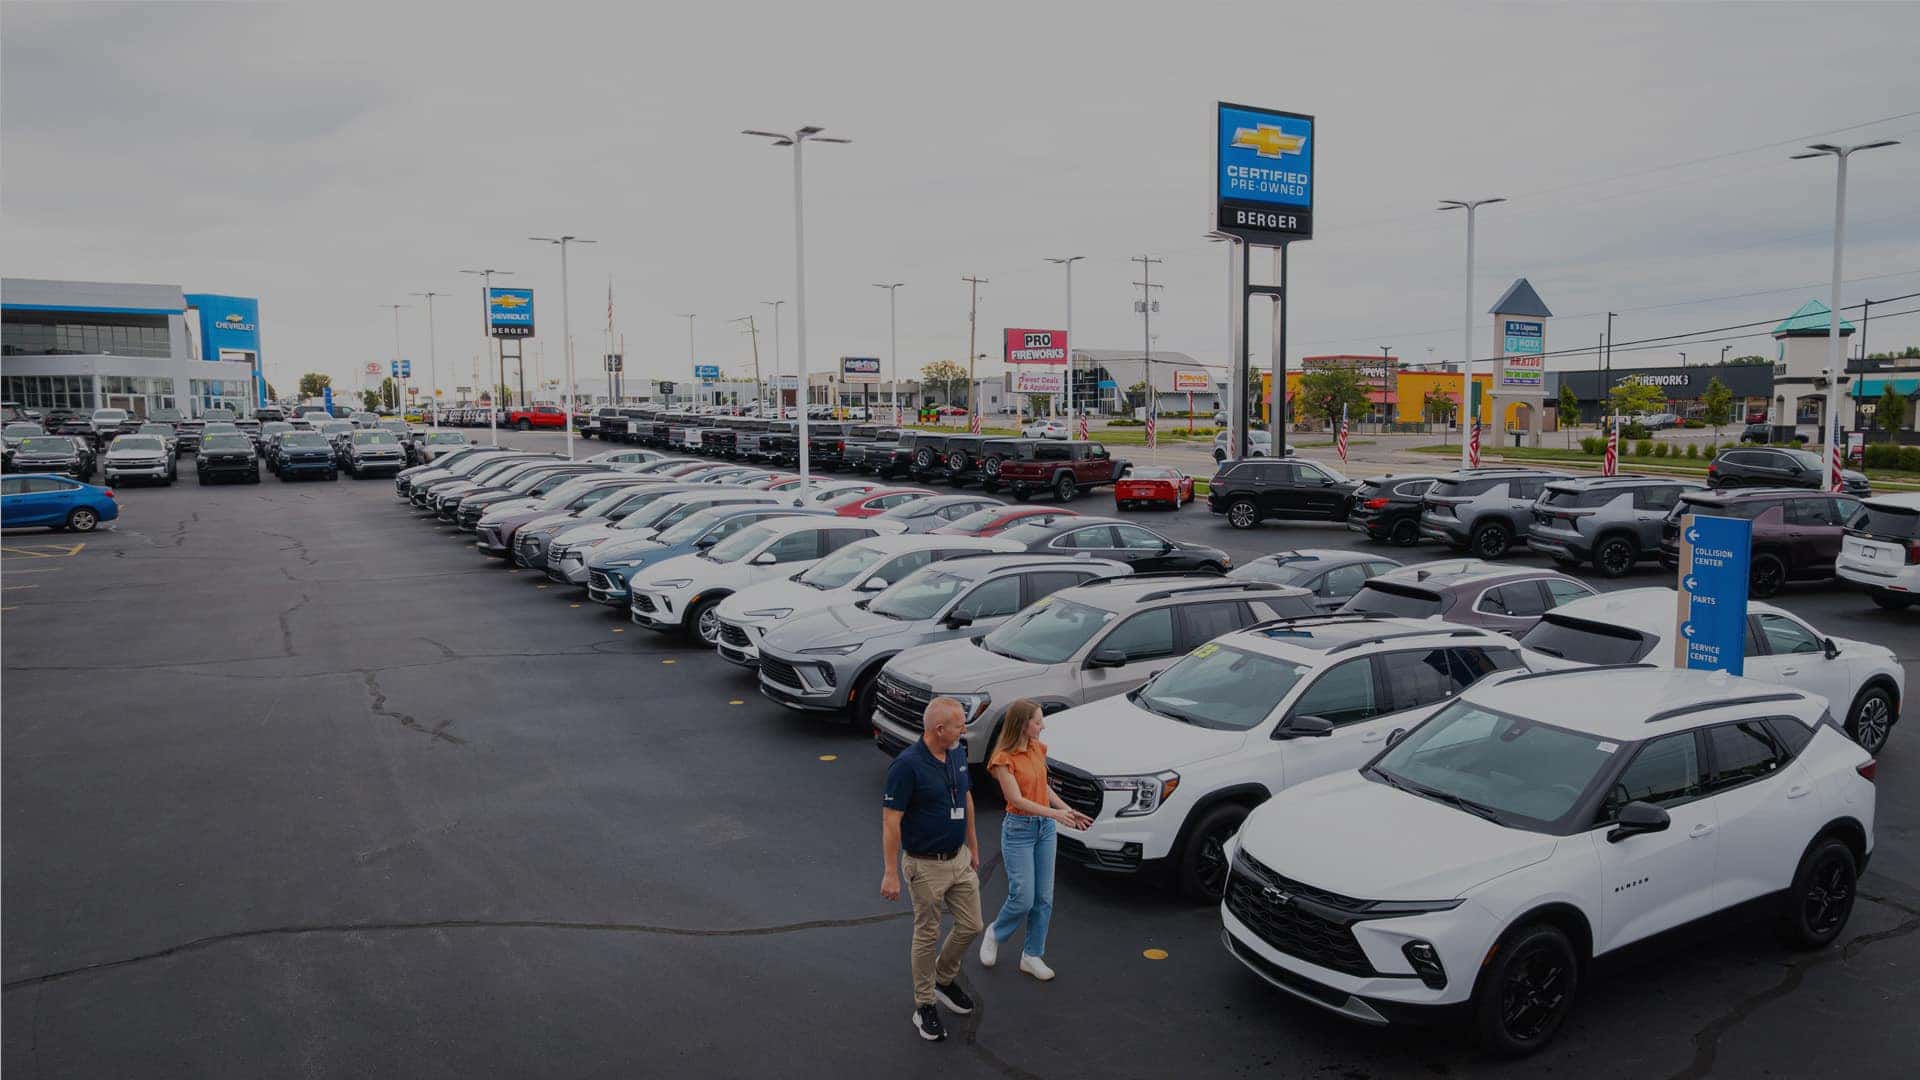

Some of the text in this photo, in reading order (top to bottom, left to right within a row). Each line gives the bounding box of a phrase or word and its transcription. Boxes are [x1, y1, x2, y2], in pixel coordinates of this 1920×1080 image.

[1227, 165, 1308, 185] CERTIFIED
[1231, 178, 1304, 196] PRE-OWNED
[1237, 211, 1297, 229] BERGER
[1025, 335, 1051, 346] PRO
[1011, 348, 1065, 360] FIREWORKS
[1695, 548, 1733, 559] COLLISION
[1695, 558, 1723, 567] CENTER
[1693, 595, 1716, 605] PARTS
[1690, 643, 1720, 654] SERVICE
[1690, 653, 1718, 664] CENTER
